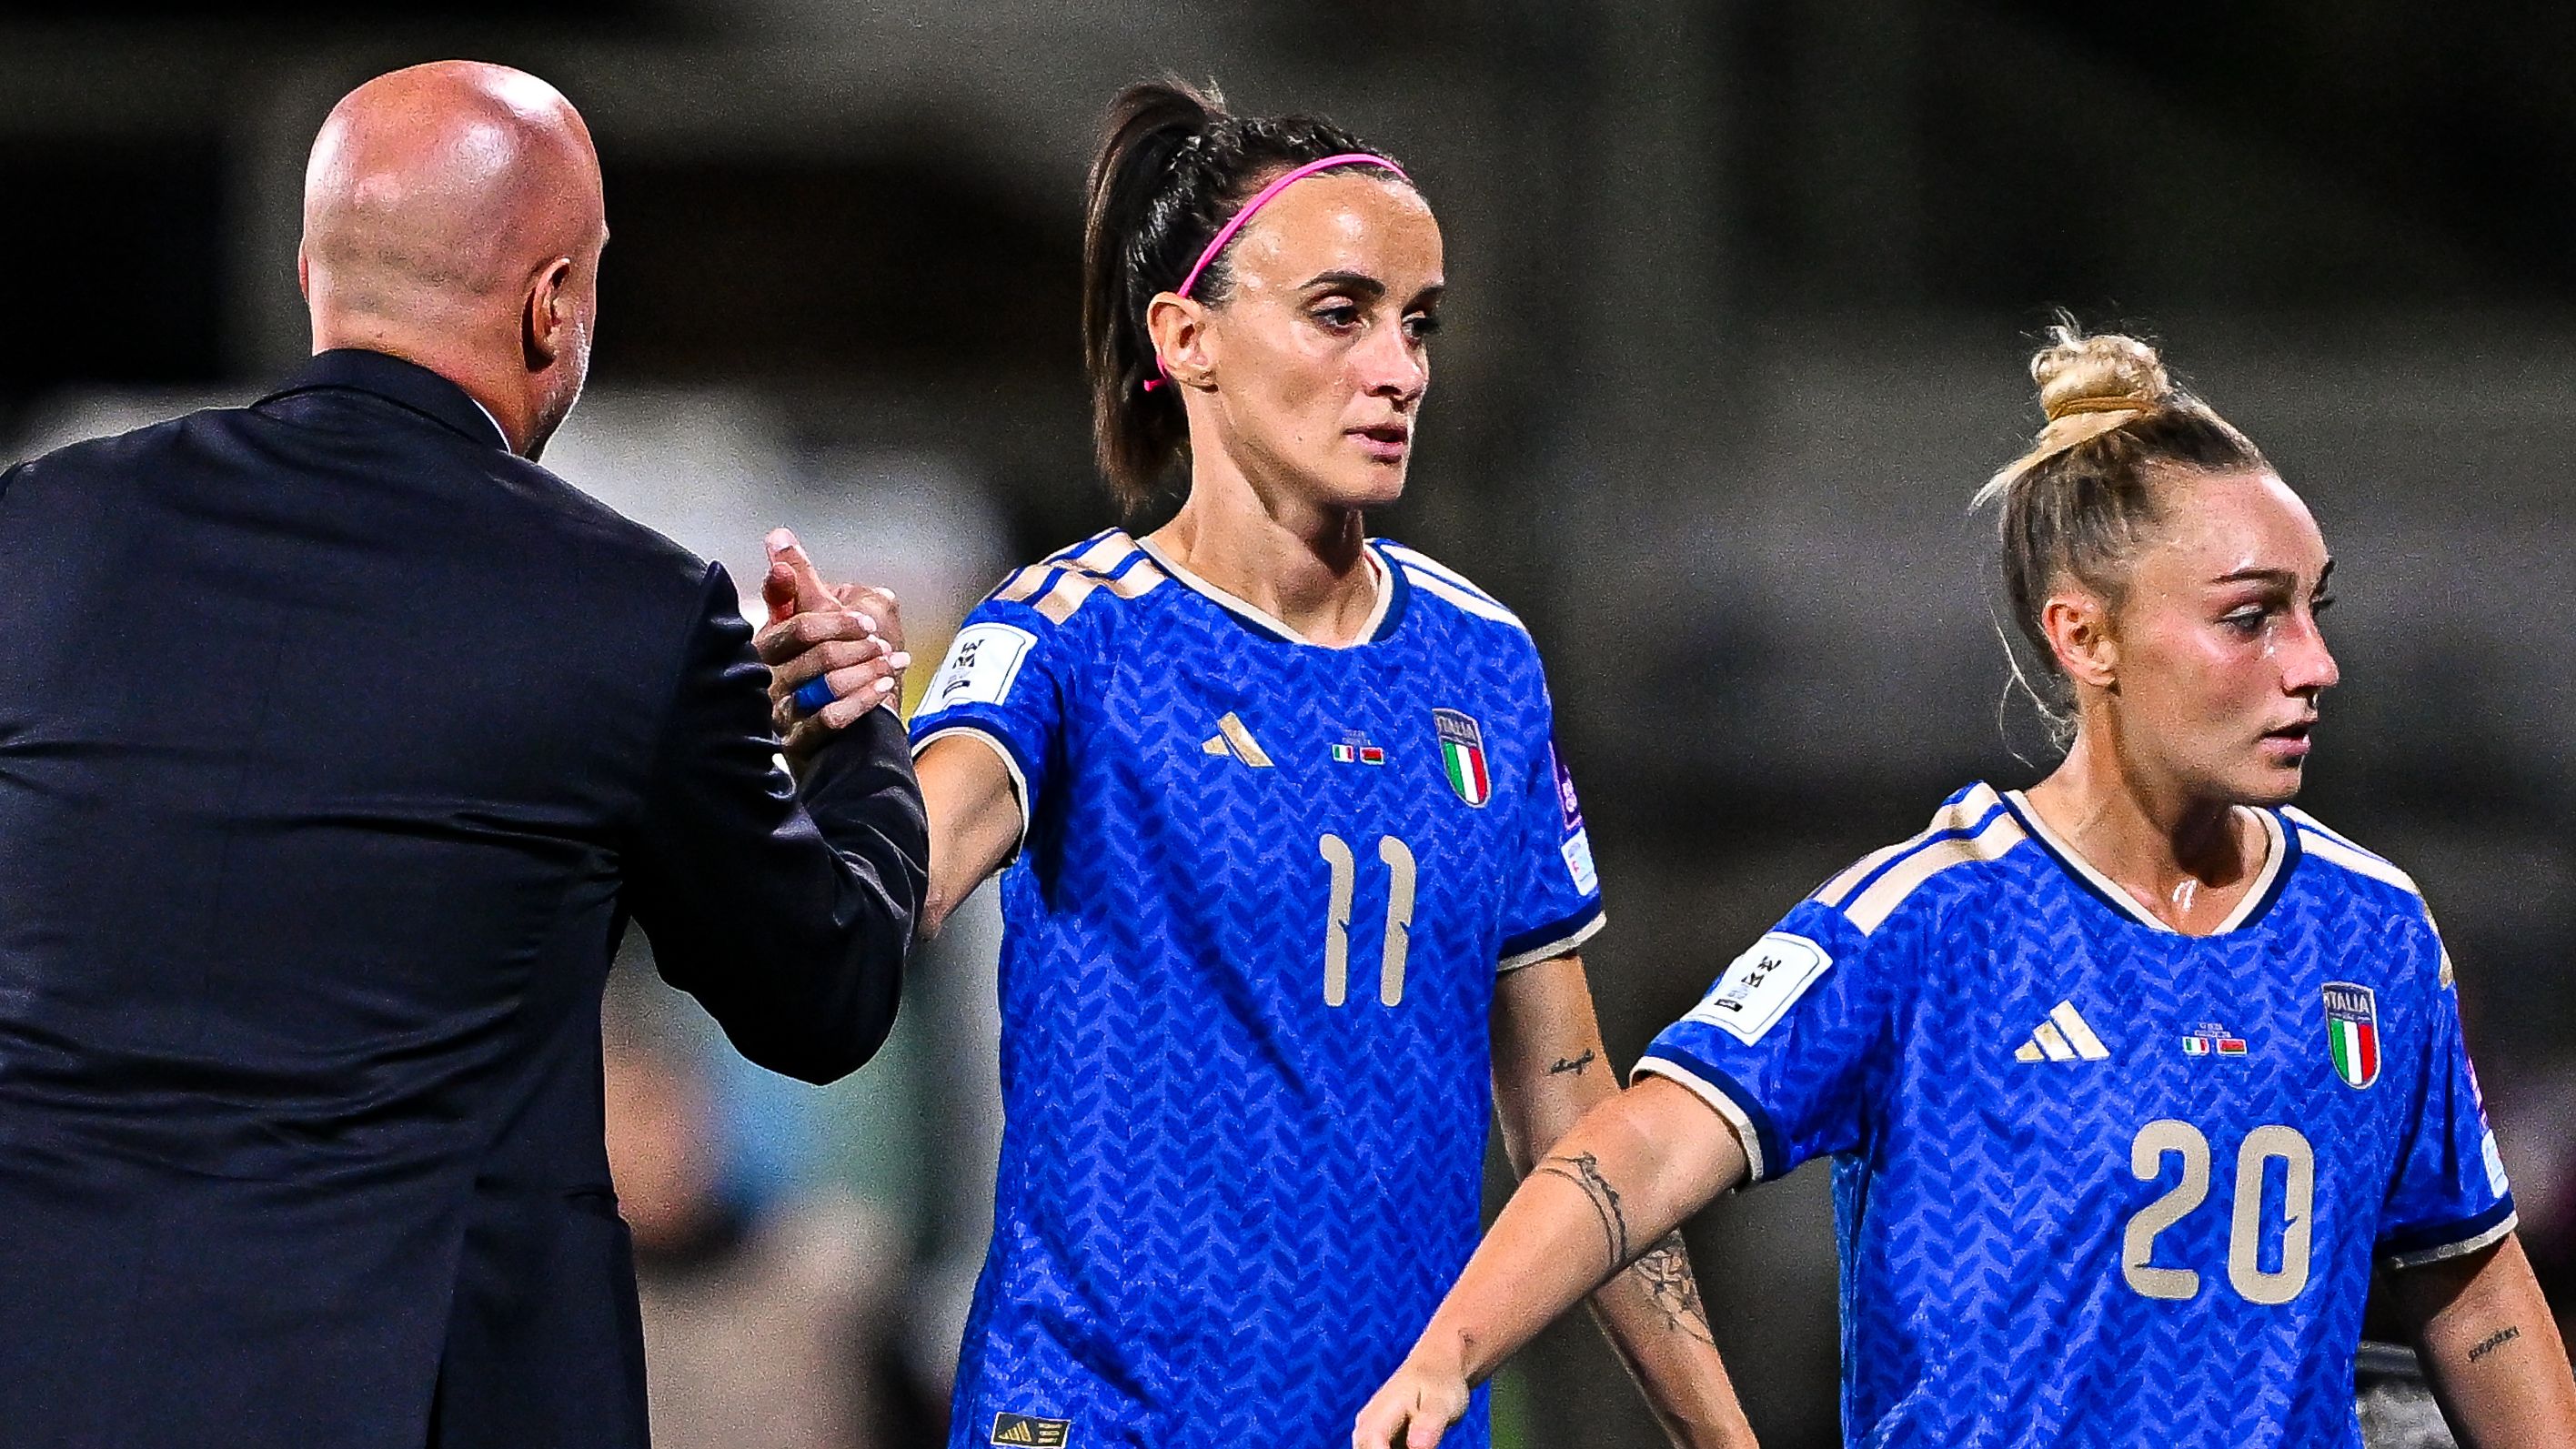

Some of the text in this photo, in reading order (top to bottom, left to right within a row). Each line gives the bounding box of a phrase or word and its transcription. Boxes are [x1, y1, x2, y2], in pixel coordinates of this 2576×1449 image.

[1319, 833, 1417, 1007] 11
[2323, 990, 2370, 1013] ITALIA
[2122, 1119, 2314, 1304] 20
